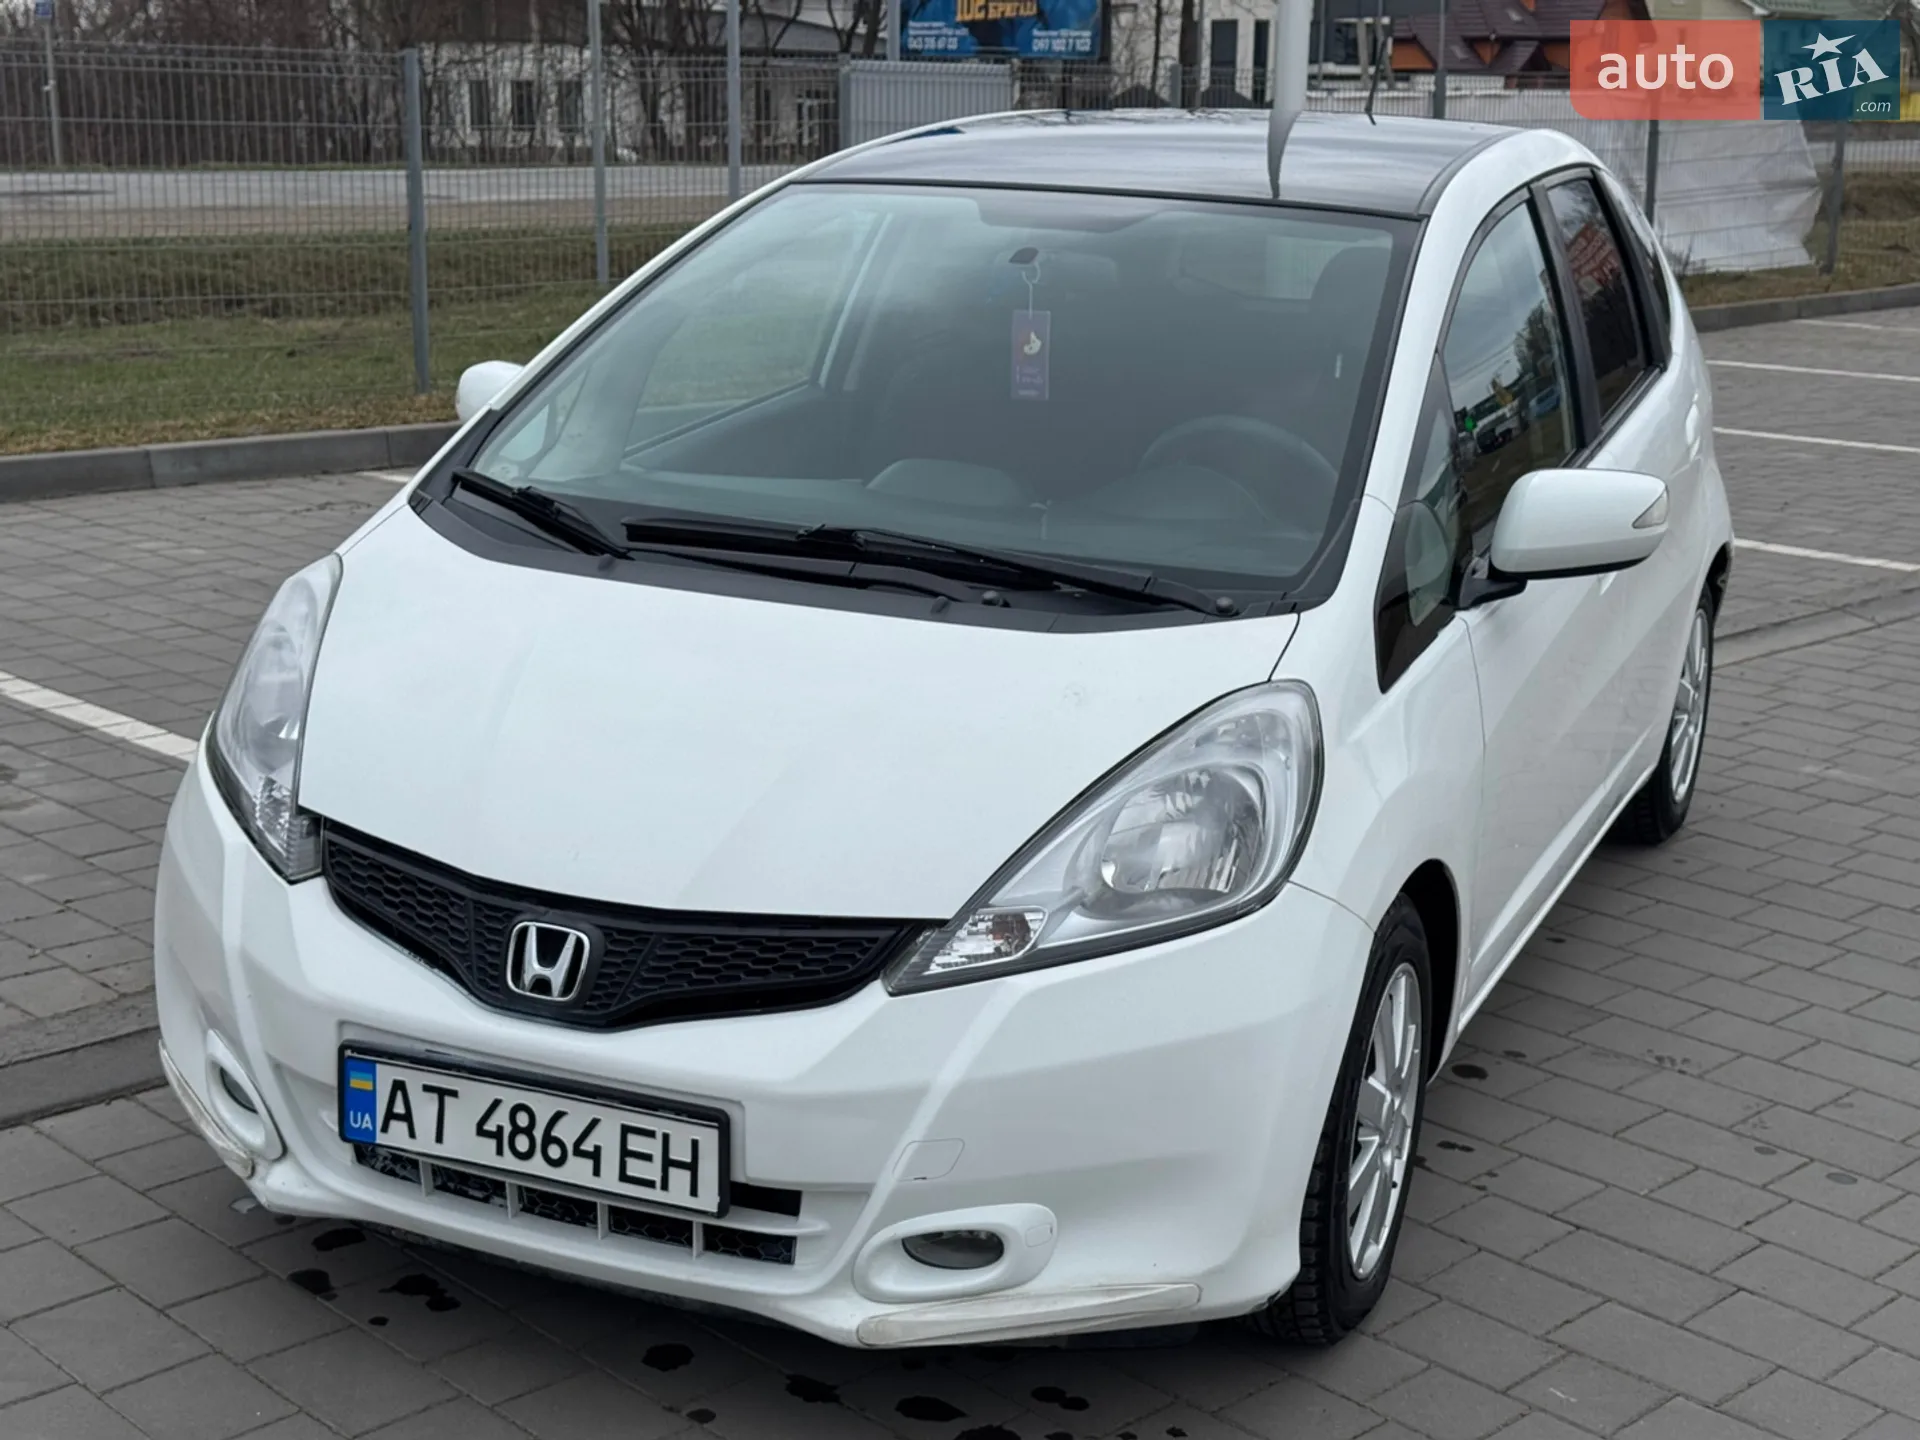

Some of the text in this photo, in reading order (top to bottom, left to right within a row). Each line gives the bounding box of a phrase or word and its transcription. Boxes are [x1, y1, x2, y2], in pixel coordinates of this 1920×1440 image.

[350, 1110, 373, 1131] UA
[380, 1078, 700, 1198] AT 4864 EH
